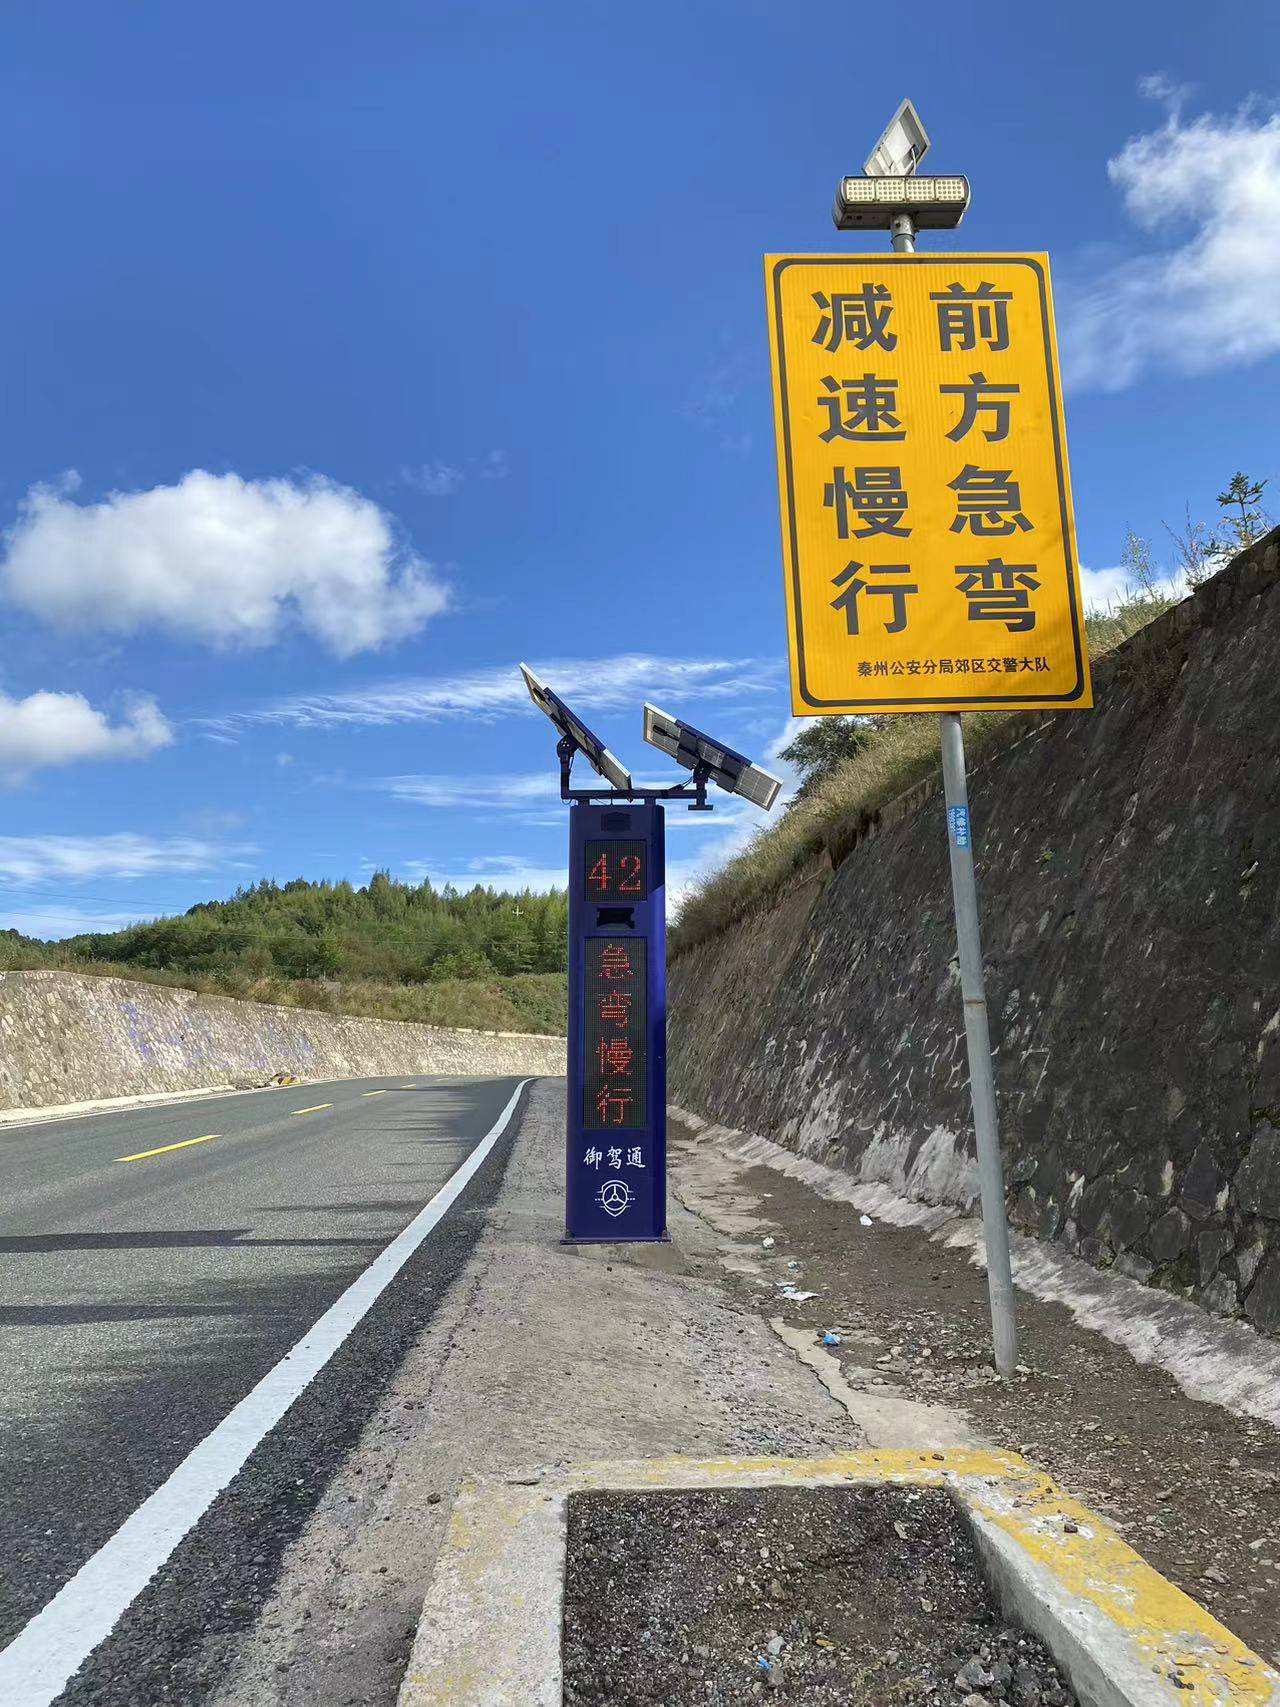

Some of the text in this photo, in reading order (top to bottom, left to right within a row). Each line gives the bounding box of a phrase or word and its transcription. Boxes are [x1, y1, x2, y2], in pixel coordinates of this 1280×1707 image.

[811, 282, 918, 635] 减速慢行
[929, 281, 1042, 633] 前方急弯
[857, 656, 1051, 677] 秦州公安分局郊区交警大队
[588, 853, 641, 892] 42
[595, 943, 634, 1124] 急弯慢行
[583, 1146, 646, 1170] 御驾通
